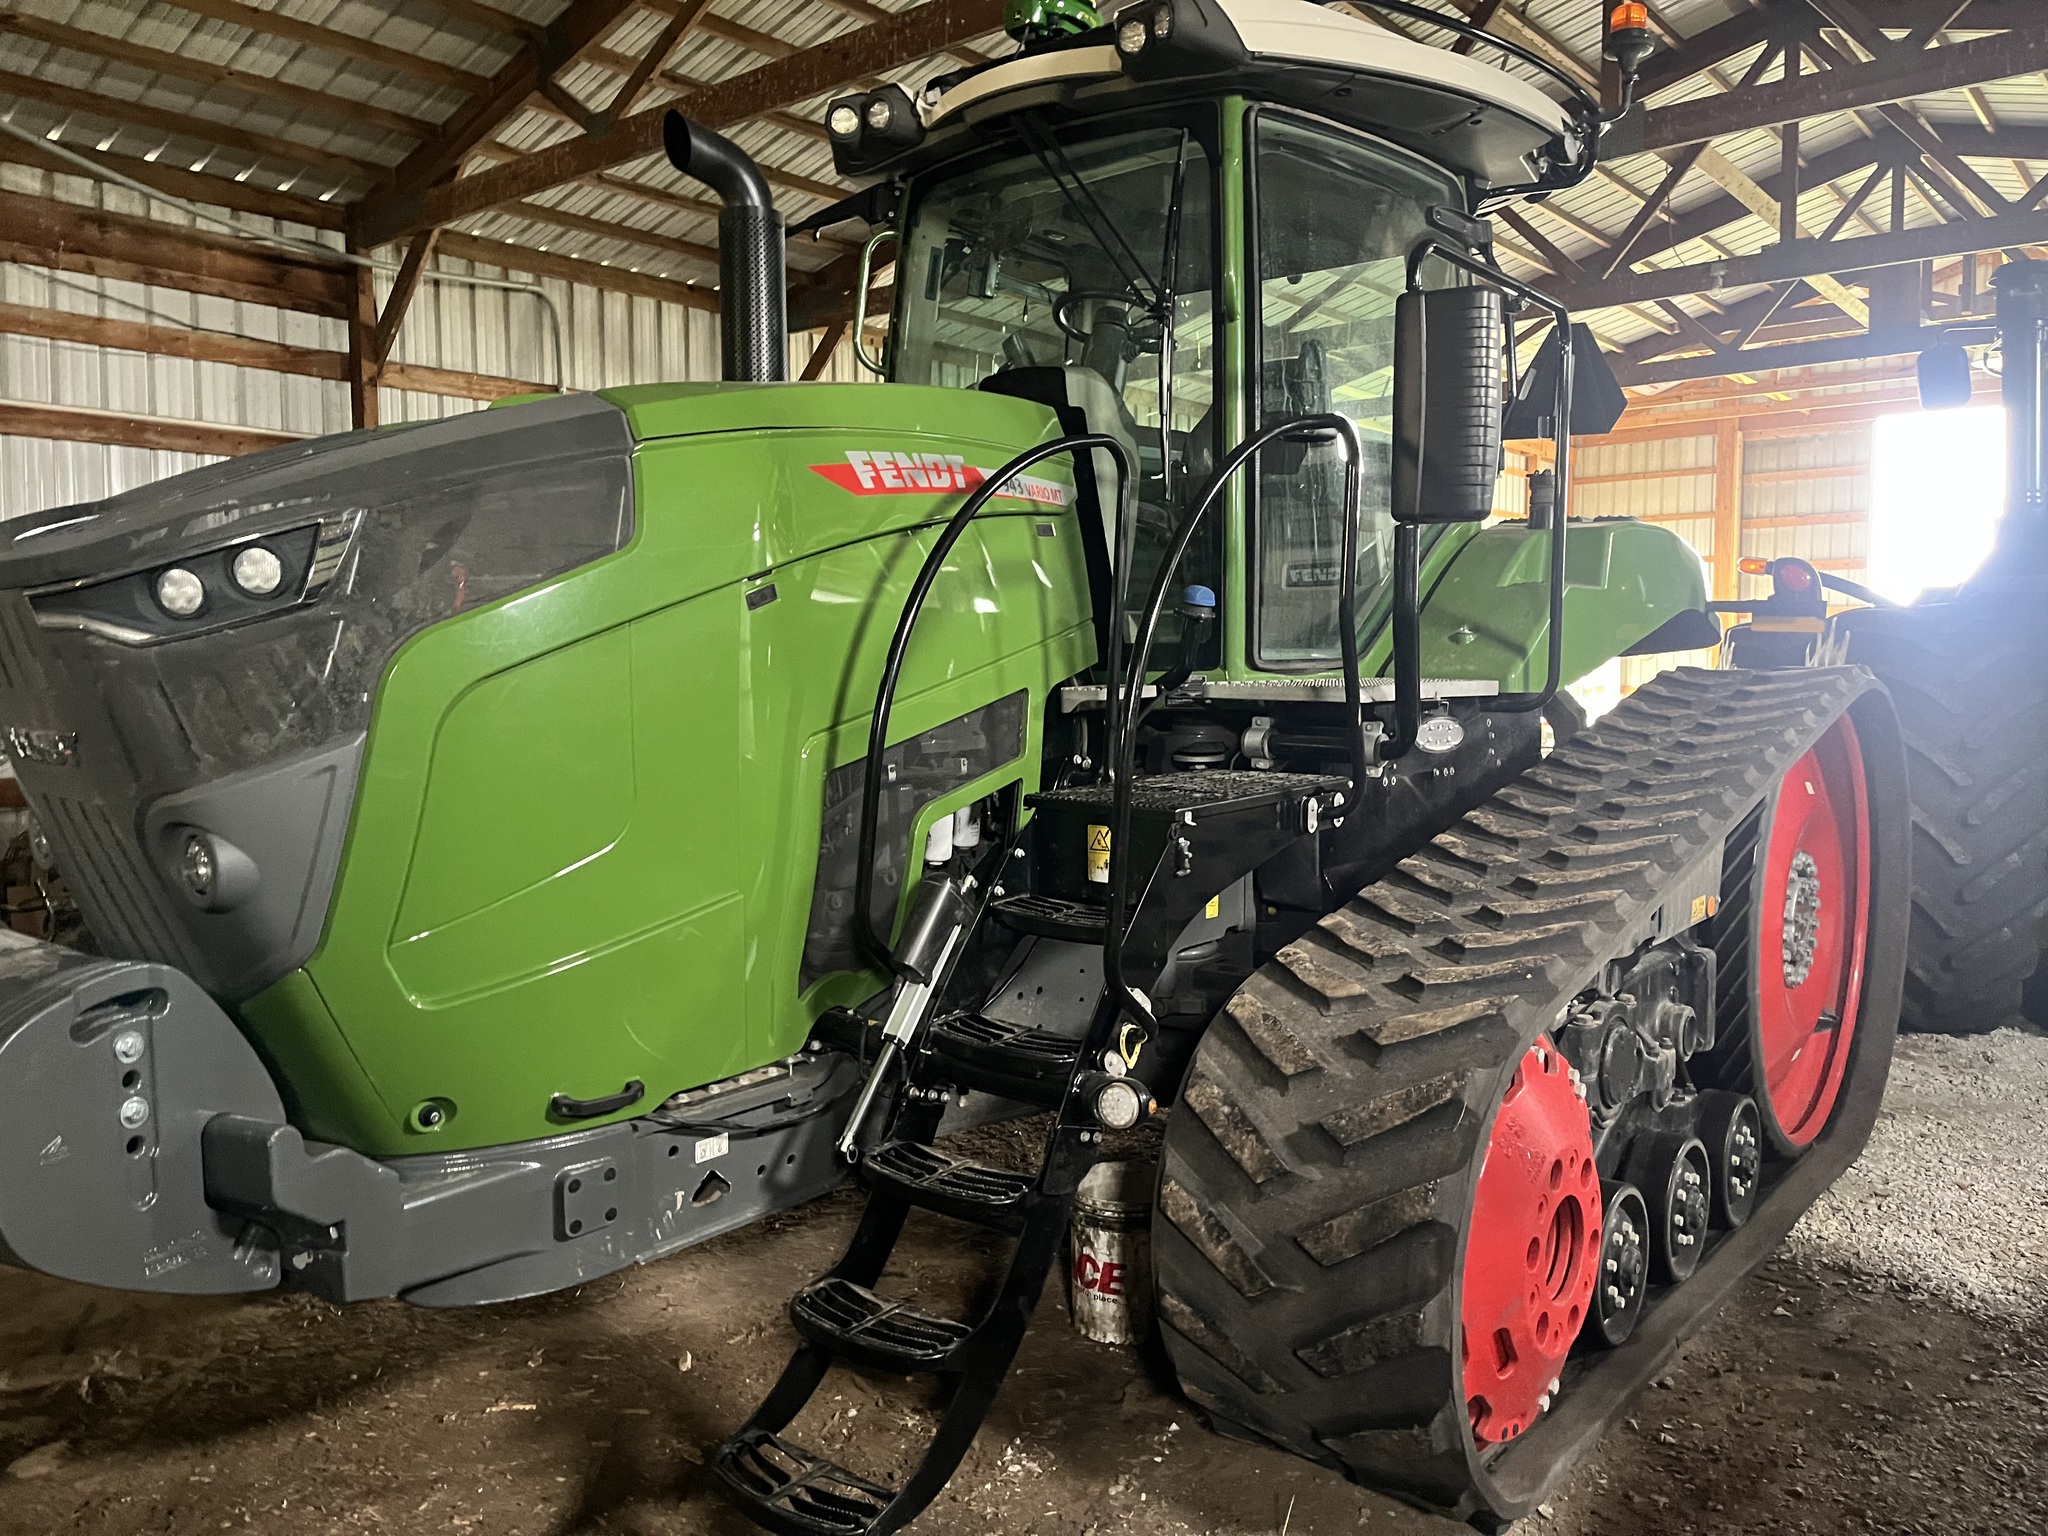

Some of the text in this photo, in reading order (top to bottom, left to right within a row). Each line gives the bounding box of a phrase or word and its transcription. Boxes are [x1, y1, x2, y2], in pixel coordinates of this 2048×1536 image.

[844, 450, 966, 489] FENDT
[1025, 483, 1050, 501] VARIO
[1050, 488, 1063, 503] MT
[1289, 567, 1341, 582] FEND
